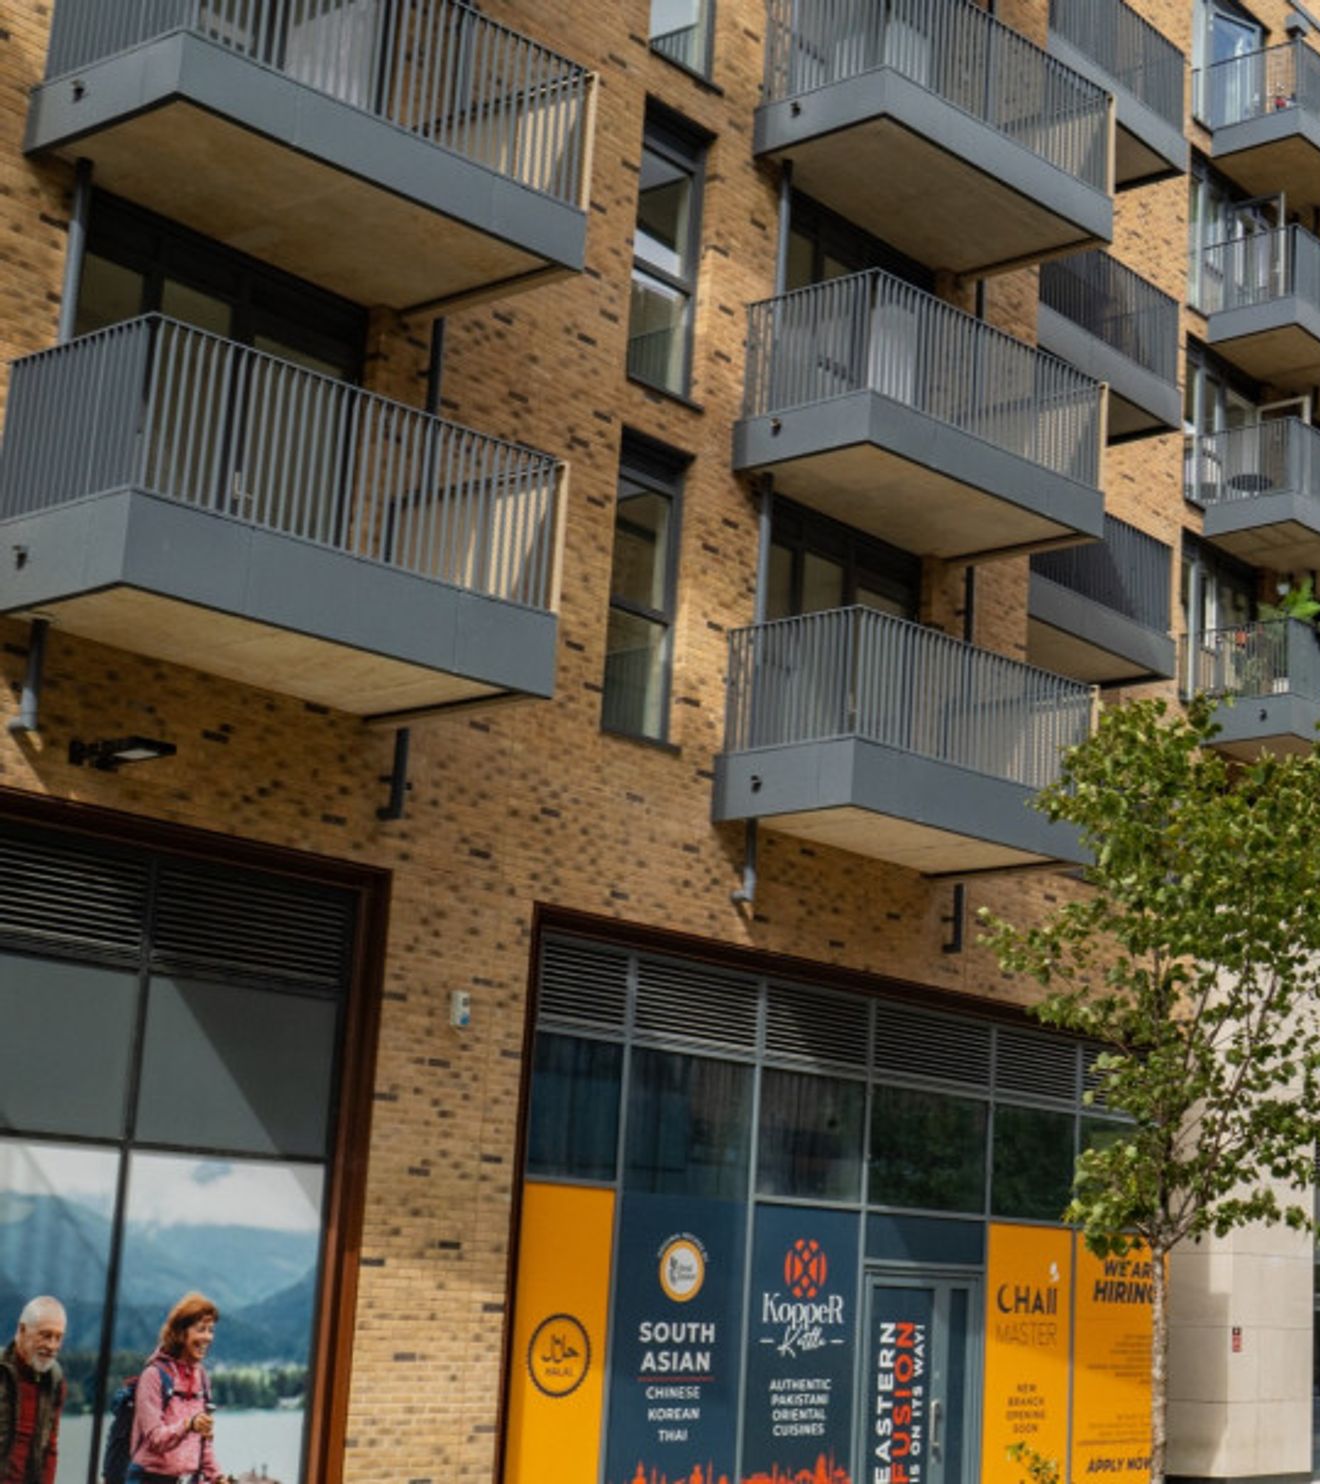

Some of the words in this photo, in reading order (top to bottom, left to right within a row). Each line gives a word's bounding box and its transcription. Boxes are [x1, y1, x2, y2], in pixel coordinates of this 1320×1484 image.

[1104, 1260, 1131, 1276] WE
[1132, 1261, 1153, 1278] AR
[638, 1321, 716, 1343] SOUTH
[995, 1322, 1057, 1347] MASTER
[640, 1351, 711, 1372] ASIAN
[645, 1386, 701, 1399] CHINESE
[769, 1378, 832, 1392] AUTHENTIC
[771, 1393, 830, 1407] PAKISTANI
[874, 1322, 896, 1484] EASTERN
[891, 1321, 915, 1484] FUSION
[911, 1385, 924, 1417] ITS
[1008, 1397, 1045, 1407] BRANCH
[647, 1407, 700, 1421] KOREAN
[771, 1408, 827, 1421] ORIENTAL
[658, 1429, 688, 1441] THAI
[772, 1423, 826, 1437] CUISINES
[909, 1425, 922, 1456] ON
[1085, 1456, 1125, 1474] APPLY
